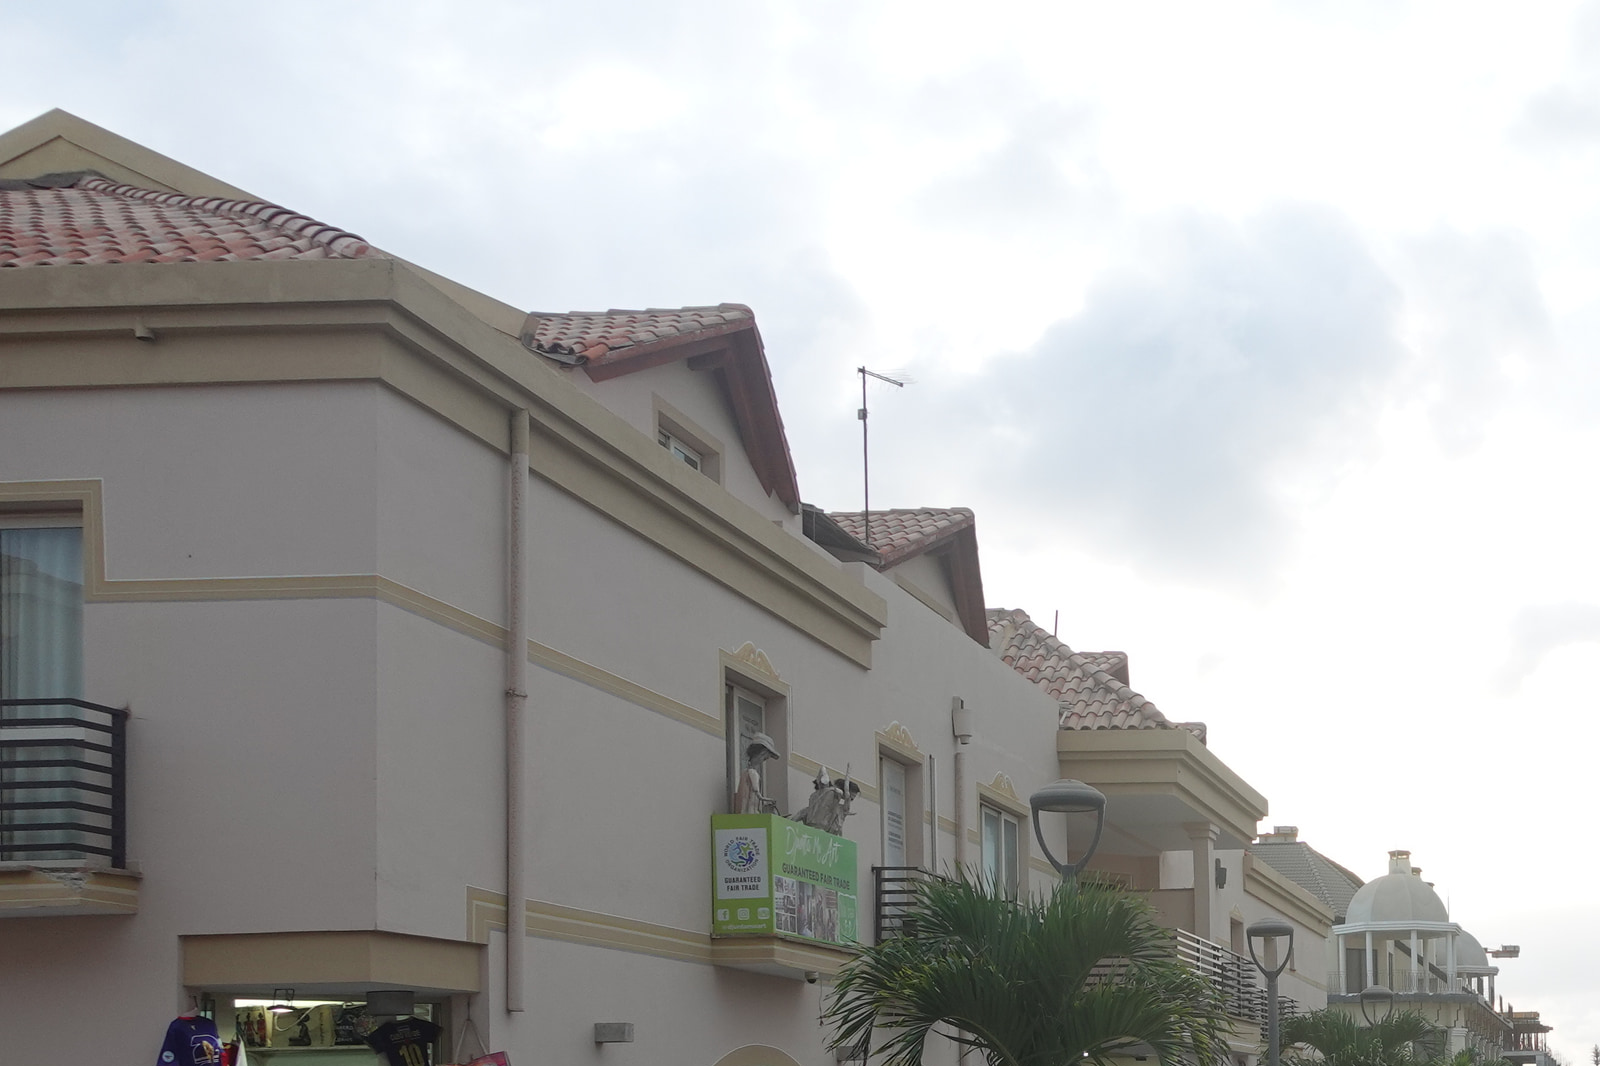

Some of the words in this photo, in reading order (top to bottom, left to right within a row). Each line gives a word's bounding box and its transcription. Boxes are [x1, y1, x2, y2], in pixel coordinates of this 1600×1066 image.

[724, 839, 735, 857] WORLD
[749, 839, 760, 856] TRADE
[725, 858, 760, 873] ORGANIZATION
[724, 876, 761, 884] GUARANTEED
[782, 862, 820, 882] GUARANTEED
[820, 873, 833, 885] FAIR
[833, 876, 851, 890] TRADE
[727, 884, 739, 892] FAIR
